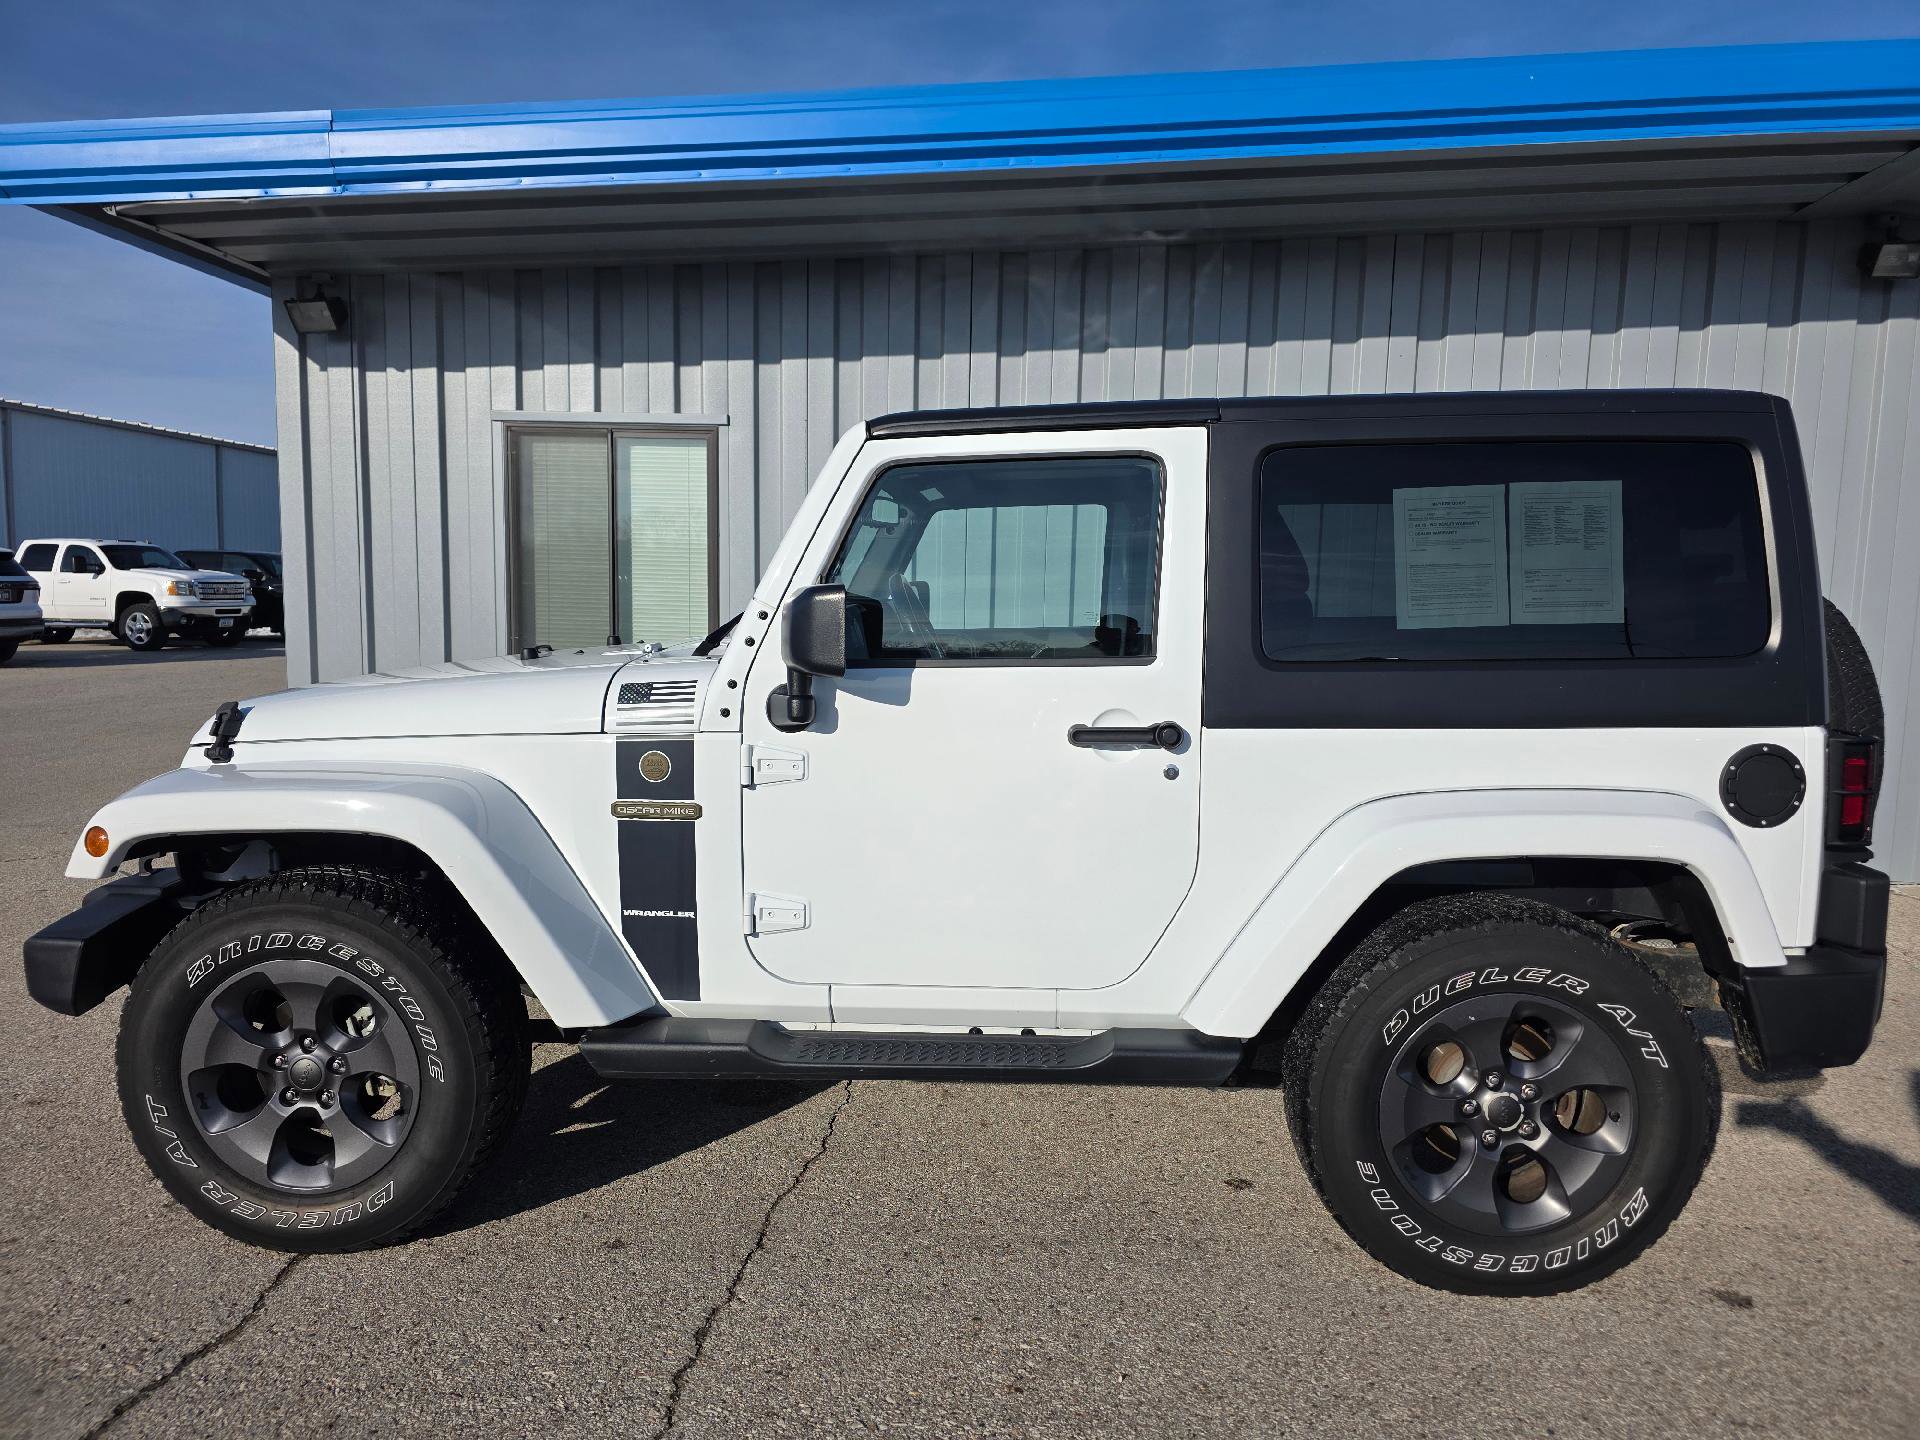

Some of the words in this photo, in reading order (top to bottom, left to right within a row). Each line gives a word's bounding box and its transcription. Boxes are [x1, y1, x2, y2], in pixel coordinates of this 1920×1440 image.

[617, 806, 660, 814] OSCAR
[663, 807, 695, 815] MIKE
[622, 909, 696, 919] WRANGLER
[186, 932, 445, 1083] BRIDGESTONE
[1382, 967, 1590, 1046] DUELER
[1597, 1002, 1669, 1069] A/T
[146, 1094, 199, 1169] A/T
[200, 1180, 395, 1229] DUELER
[1355, 1160, 1650, 1273] BRIDGESTONE
